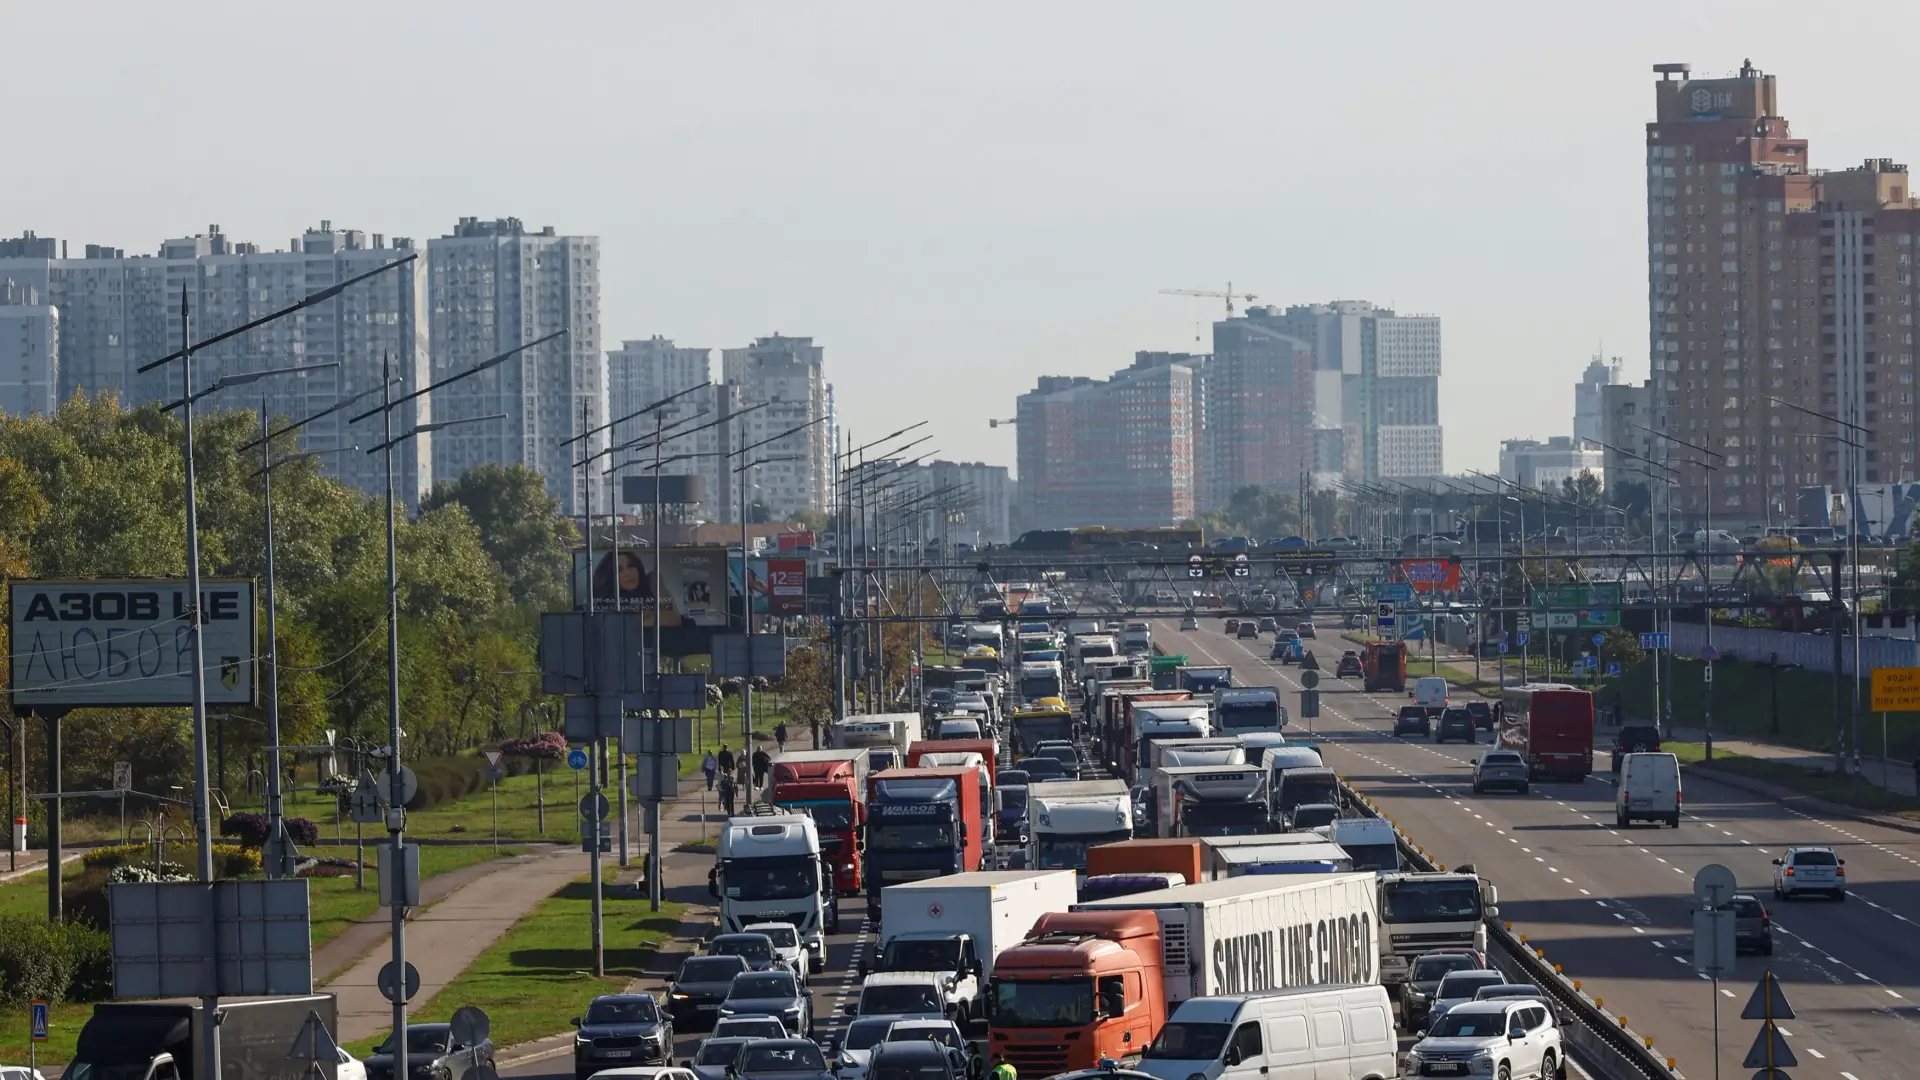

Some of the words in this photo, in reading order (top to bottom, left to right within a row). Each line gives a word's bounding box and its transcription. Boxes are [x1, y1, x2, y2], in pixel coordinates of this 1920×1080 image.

[770, 571, 788, 585] 12
[23, 592, 160, 621] АЗОВ
[173, 591, 239, 624] ЦЕ
[1279, 922, 1315, 988] LINE
[1317, 911, 1372, 985] CARGO
